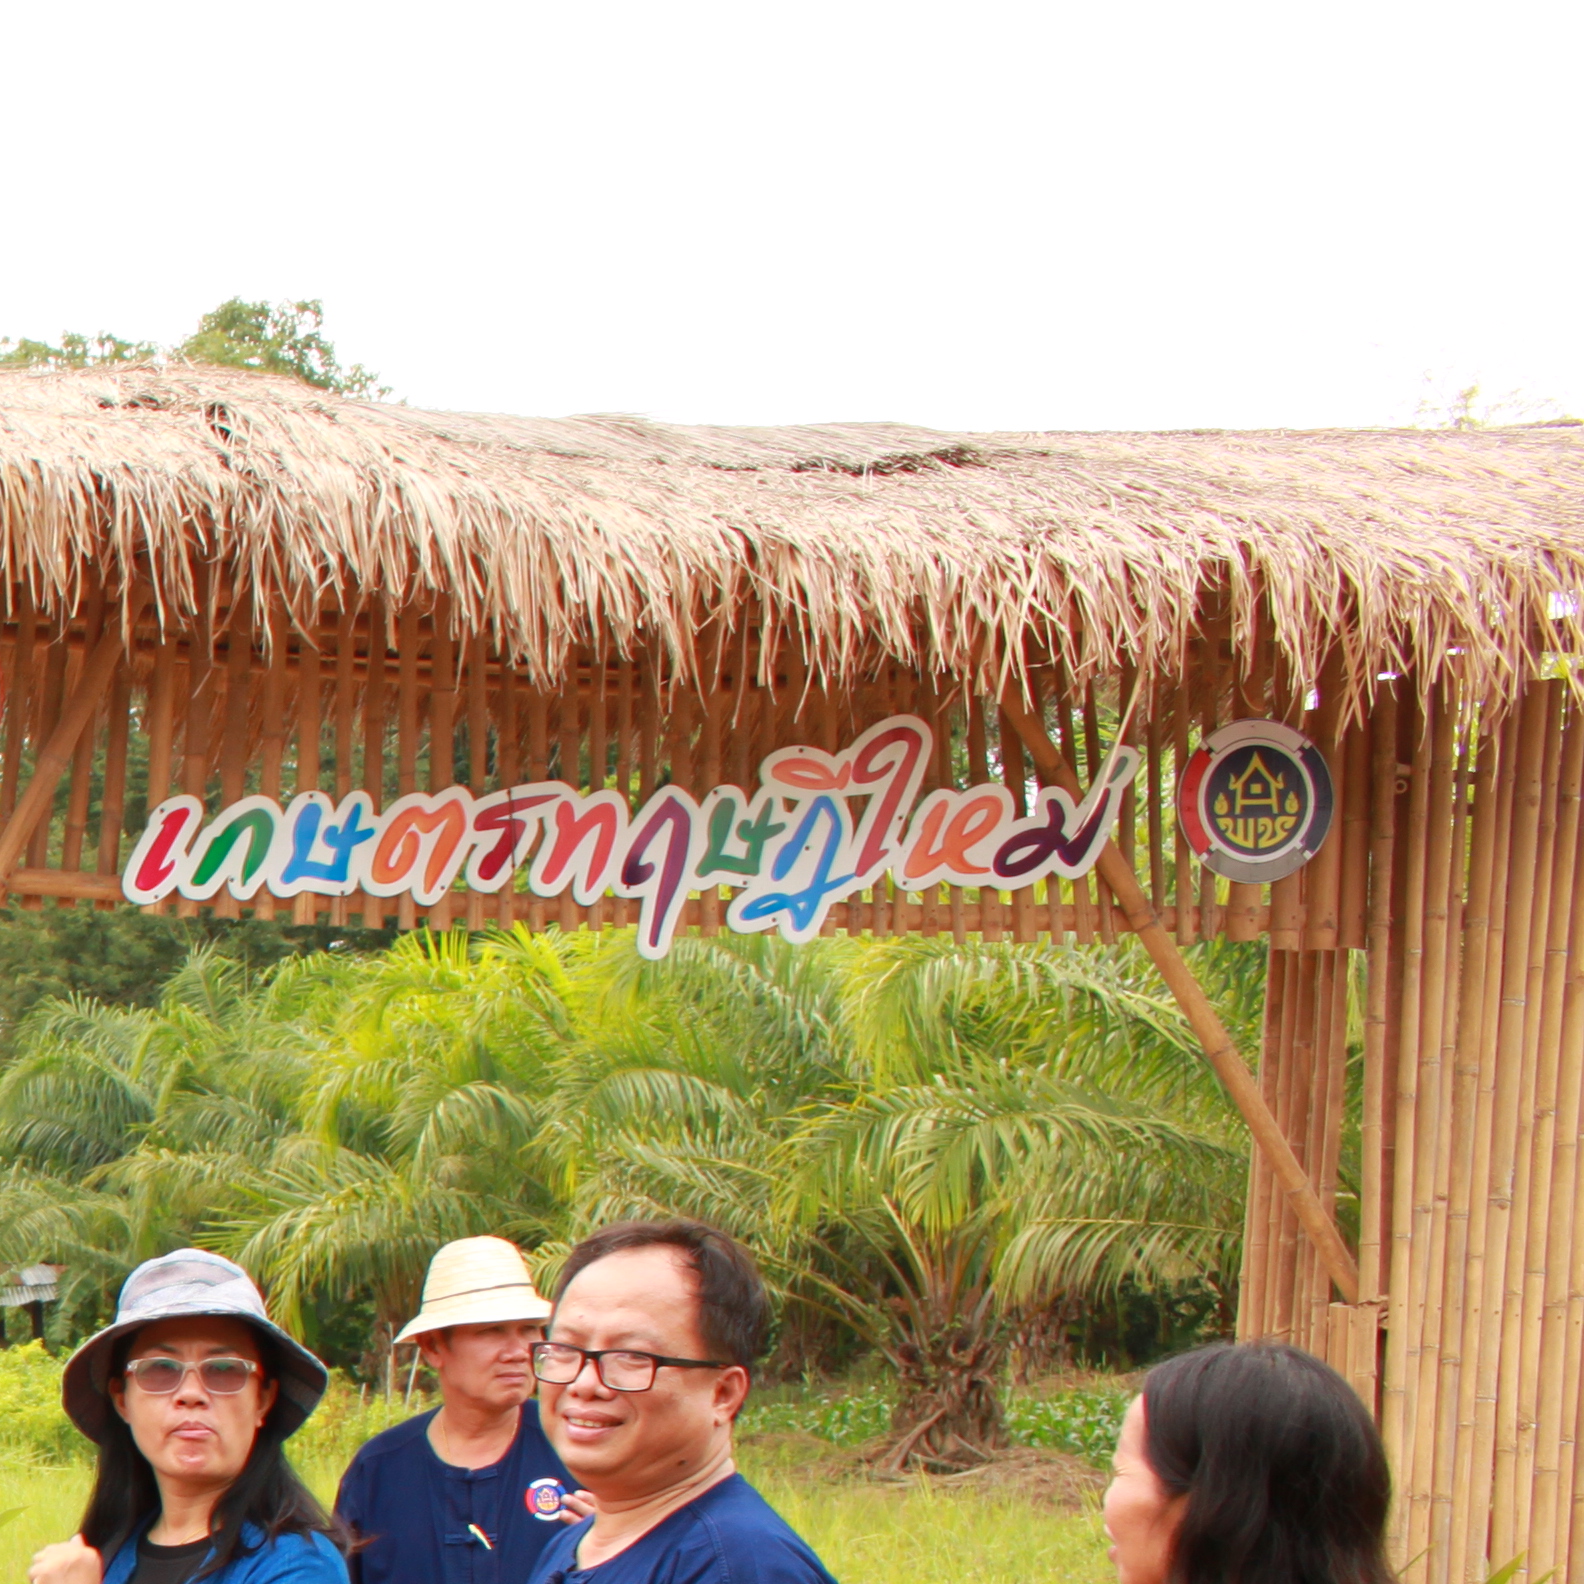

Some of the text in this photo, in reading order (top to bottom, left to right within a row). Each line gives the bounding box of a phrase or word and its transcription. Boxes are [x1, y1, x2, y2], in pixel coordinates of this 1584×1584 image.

[132, 722, 1132, 950] เกษตรทฤษฎีใหม่
